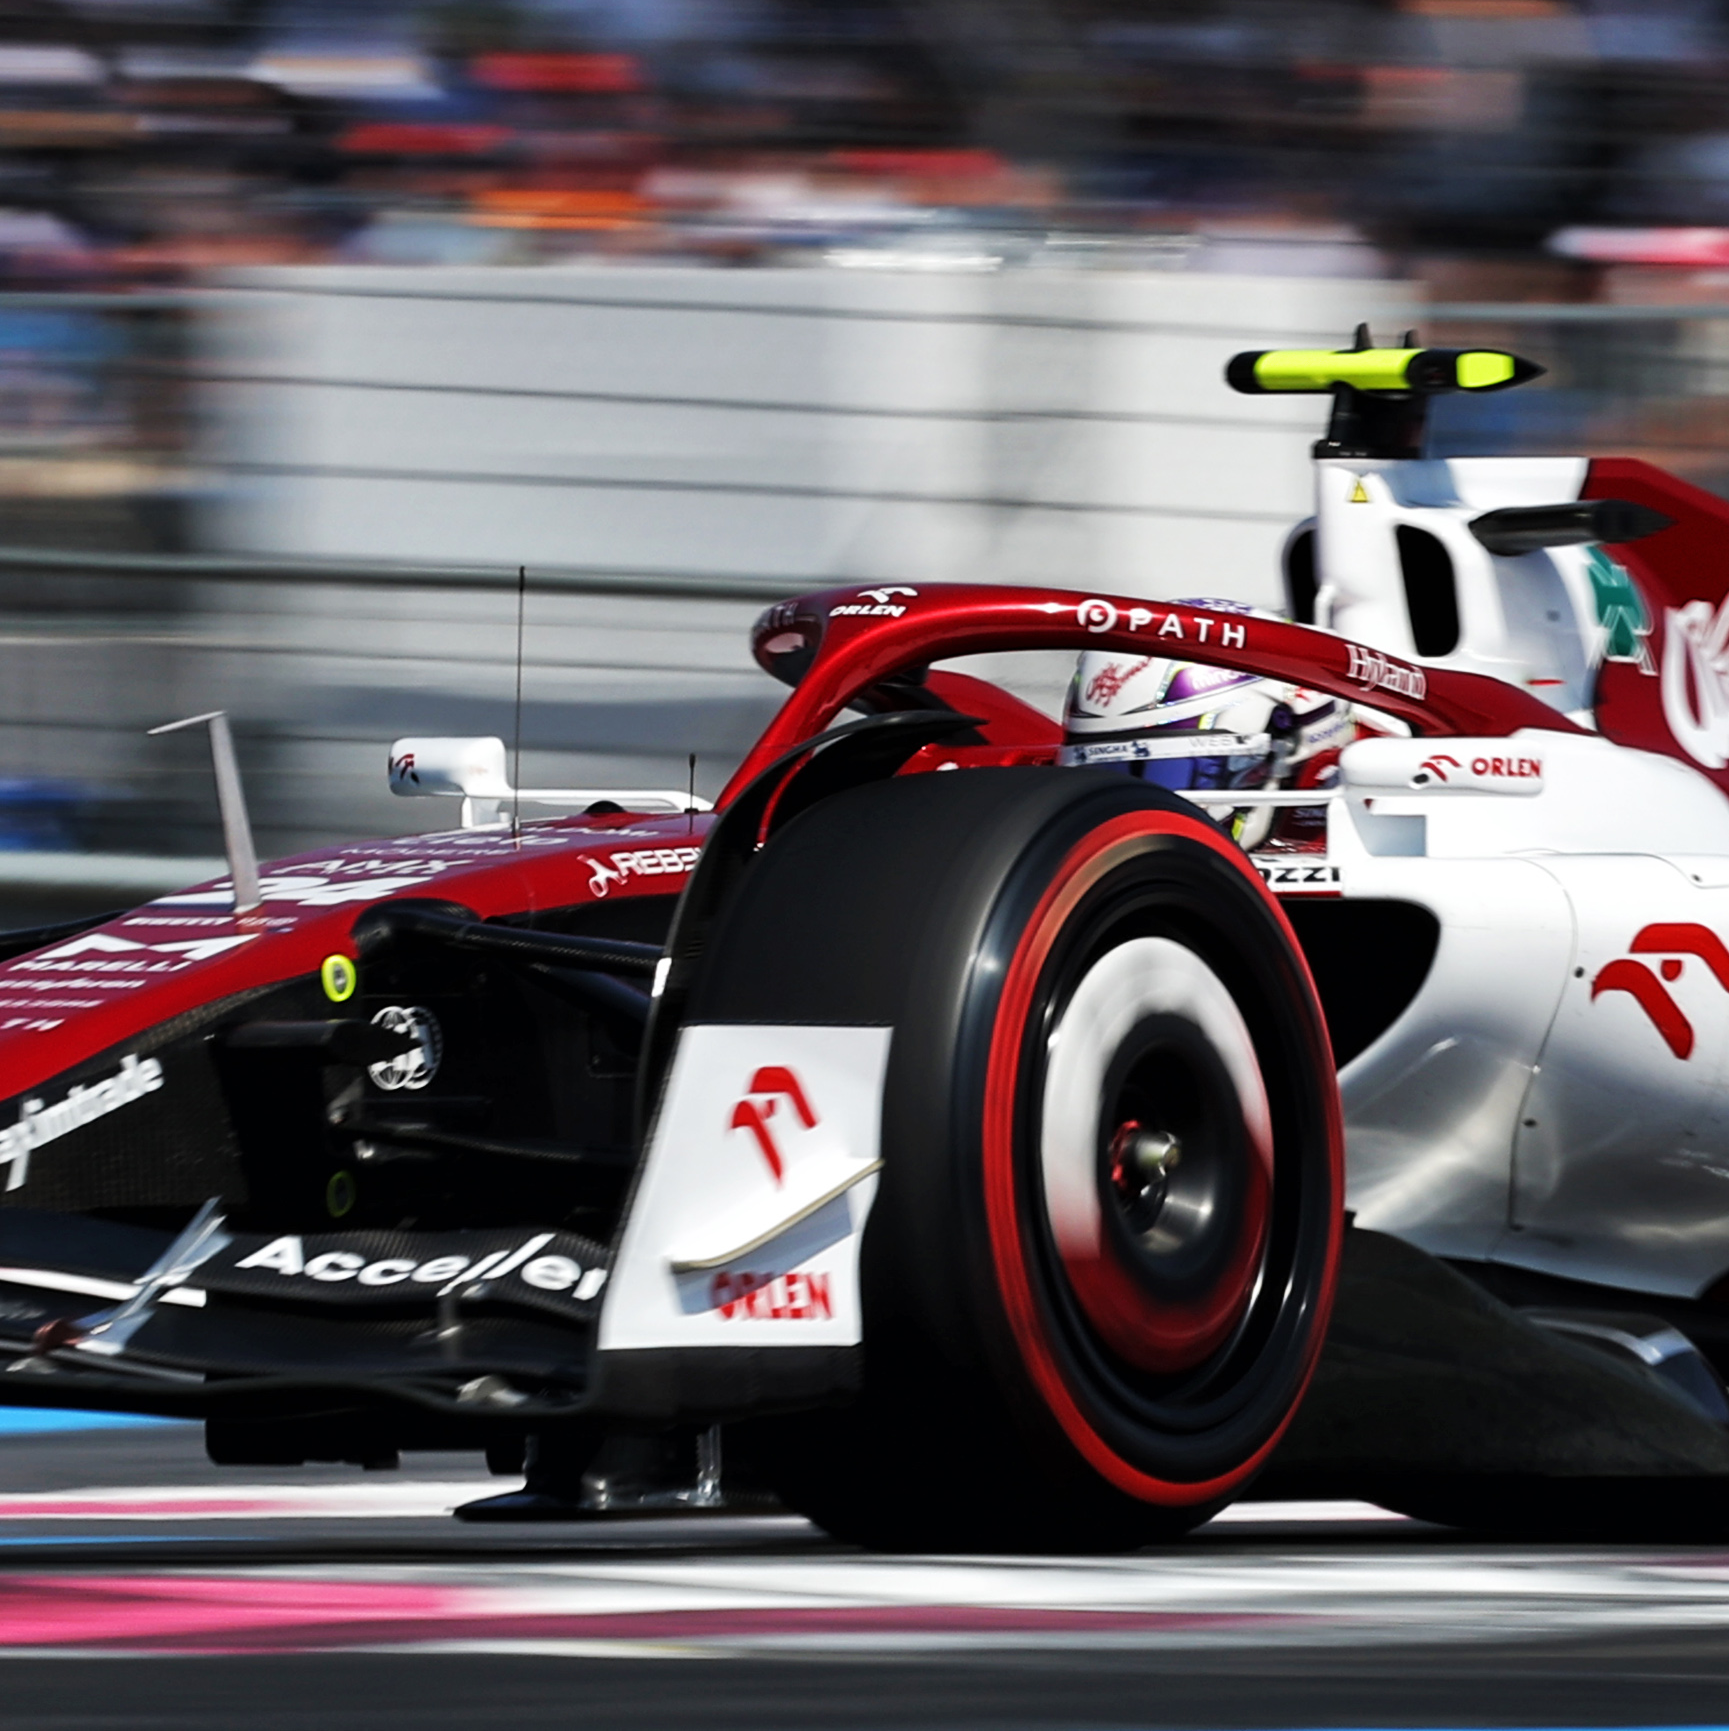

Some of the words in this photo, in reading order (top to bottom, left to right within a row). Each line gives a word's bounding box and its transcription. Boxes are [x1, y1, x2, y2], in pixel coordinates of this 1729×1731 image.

[828, 604, 907, 618] ORLEN
[1128, 607, 1248, 650] PATH
[1344, 644, 1428, 701] Hyland
[1470, 757, 1542, 778] ORLEN
[7, 960, 194, 972] MARELLI
[711, 1271, 834, 1320] ORLEN
